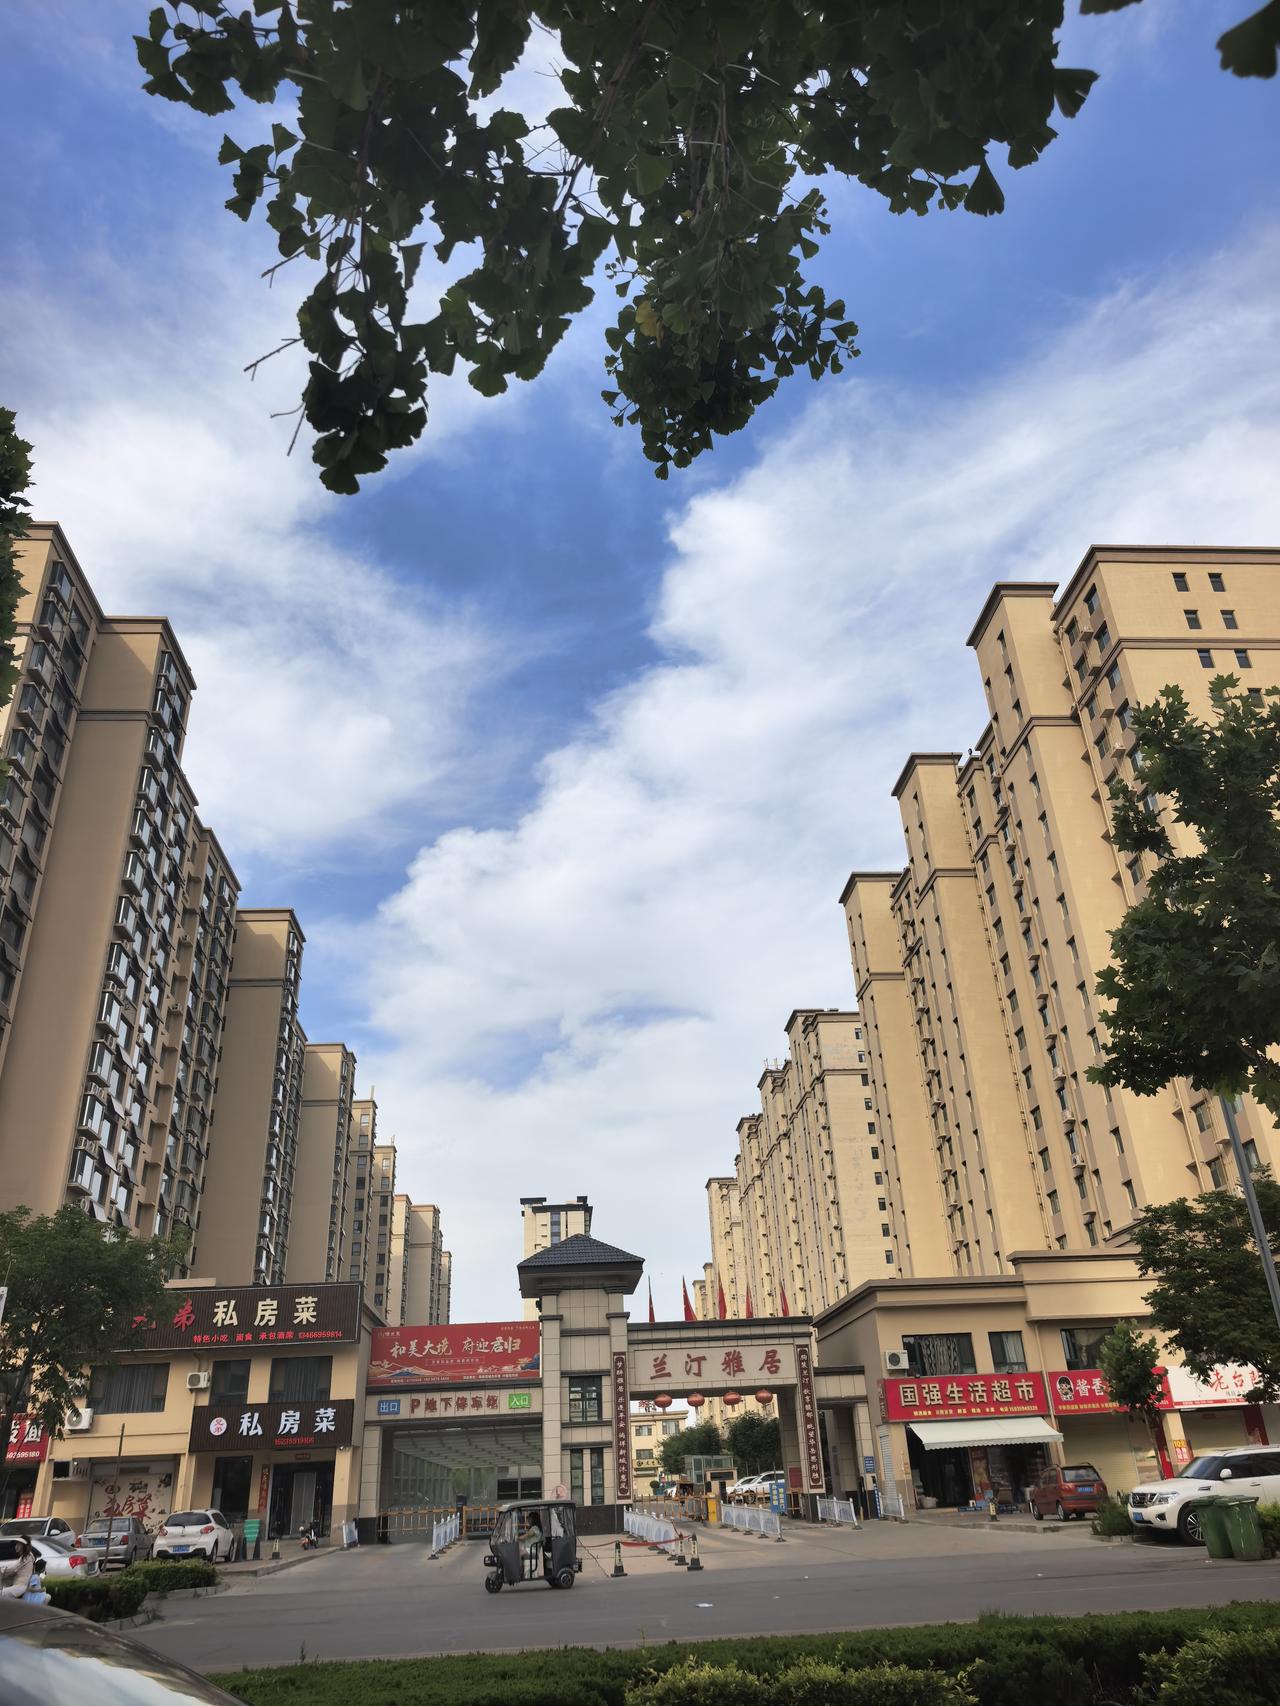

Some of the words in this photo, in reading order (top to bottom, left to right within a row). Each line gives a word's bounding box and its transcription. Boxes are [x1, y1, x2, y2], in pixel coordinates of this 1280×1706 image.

[650, 1349, 782, 1380] 兰汀雅居
[510, 1395, 529, 1407] 入口
[899, 1379, 1035, 1407] 国强生活超市
[379, 1402, 399, 1413] 出口
[238, 1408, 337, 1436] 私房菜
